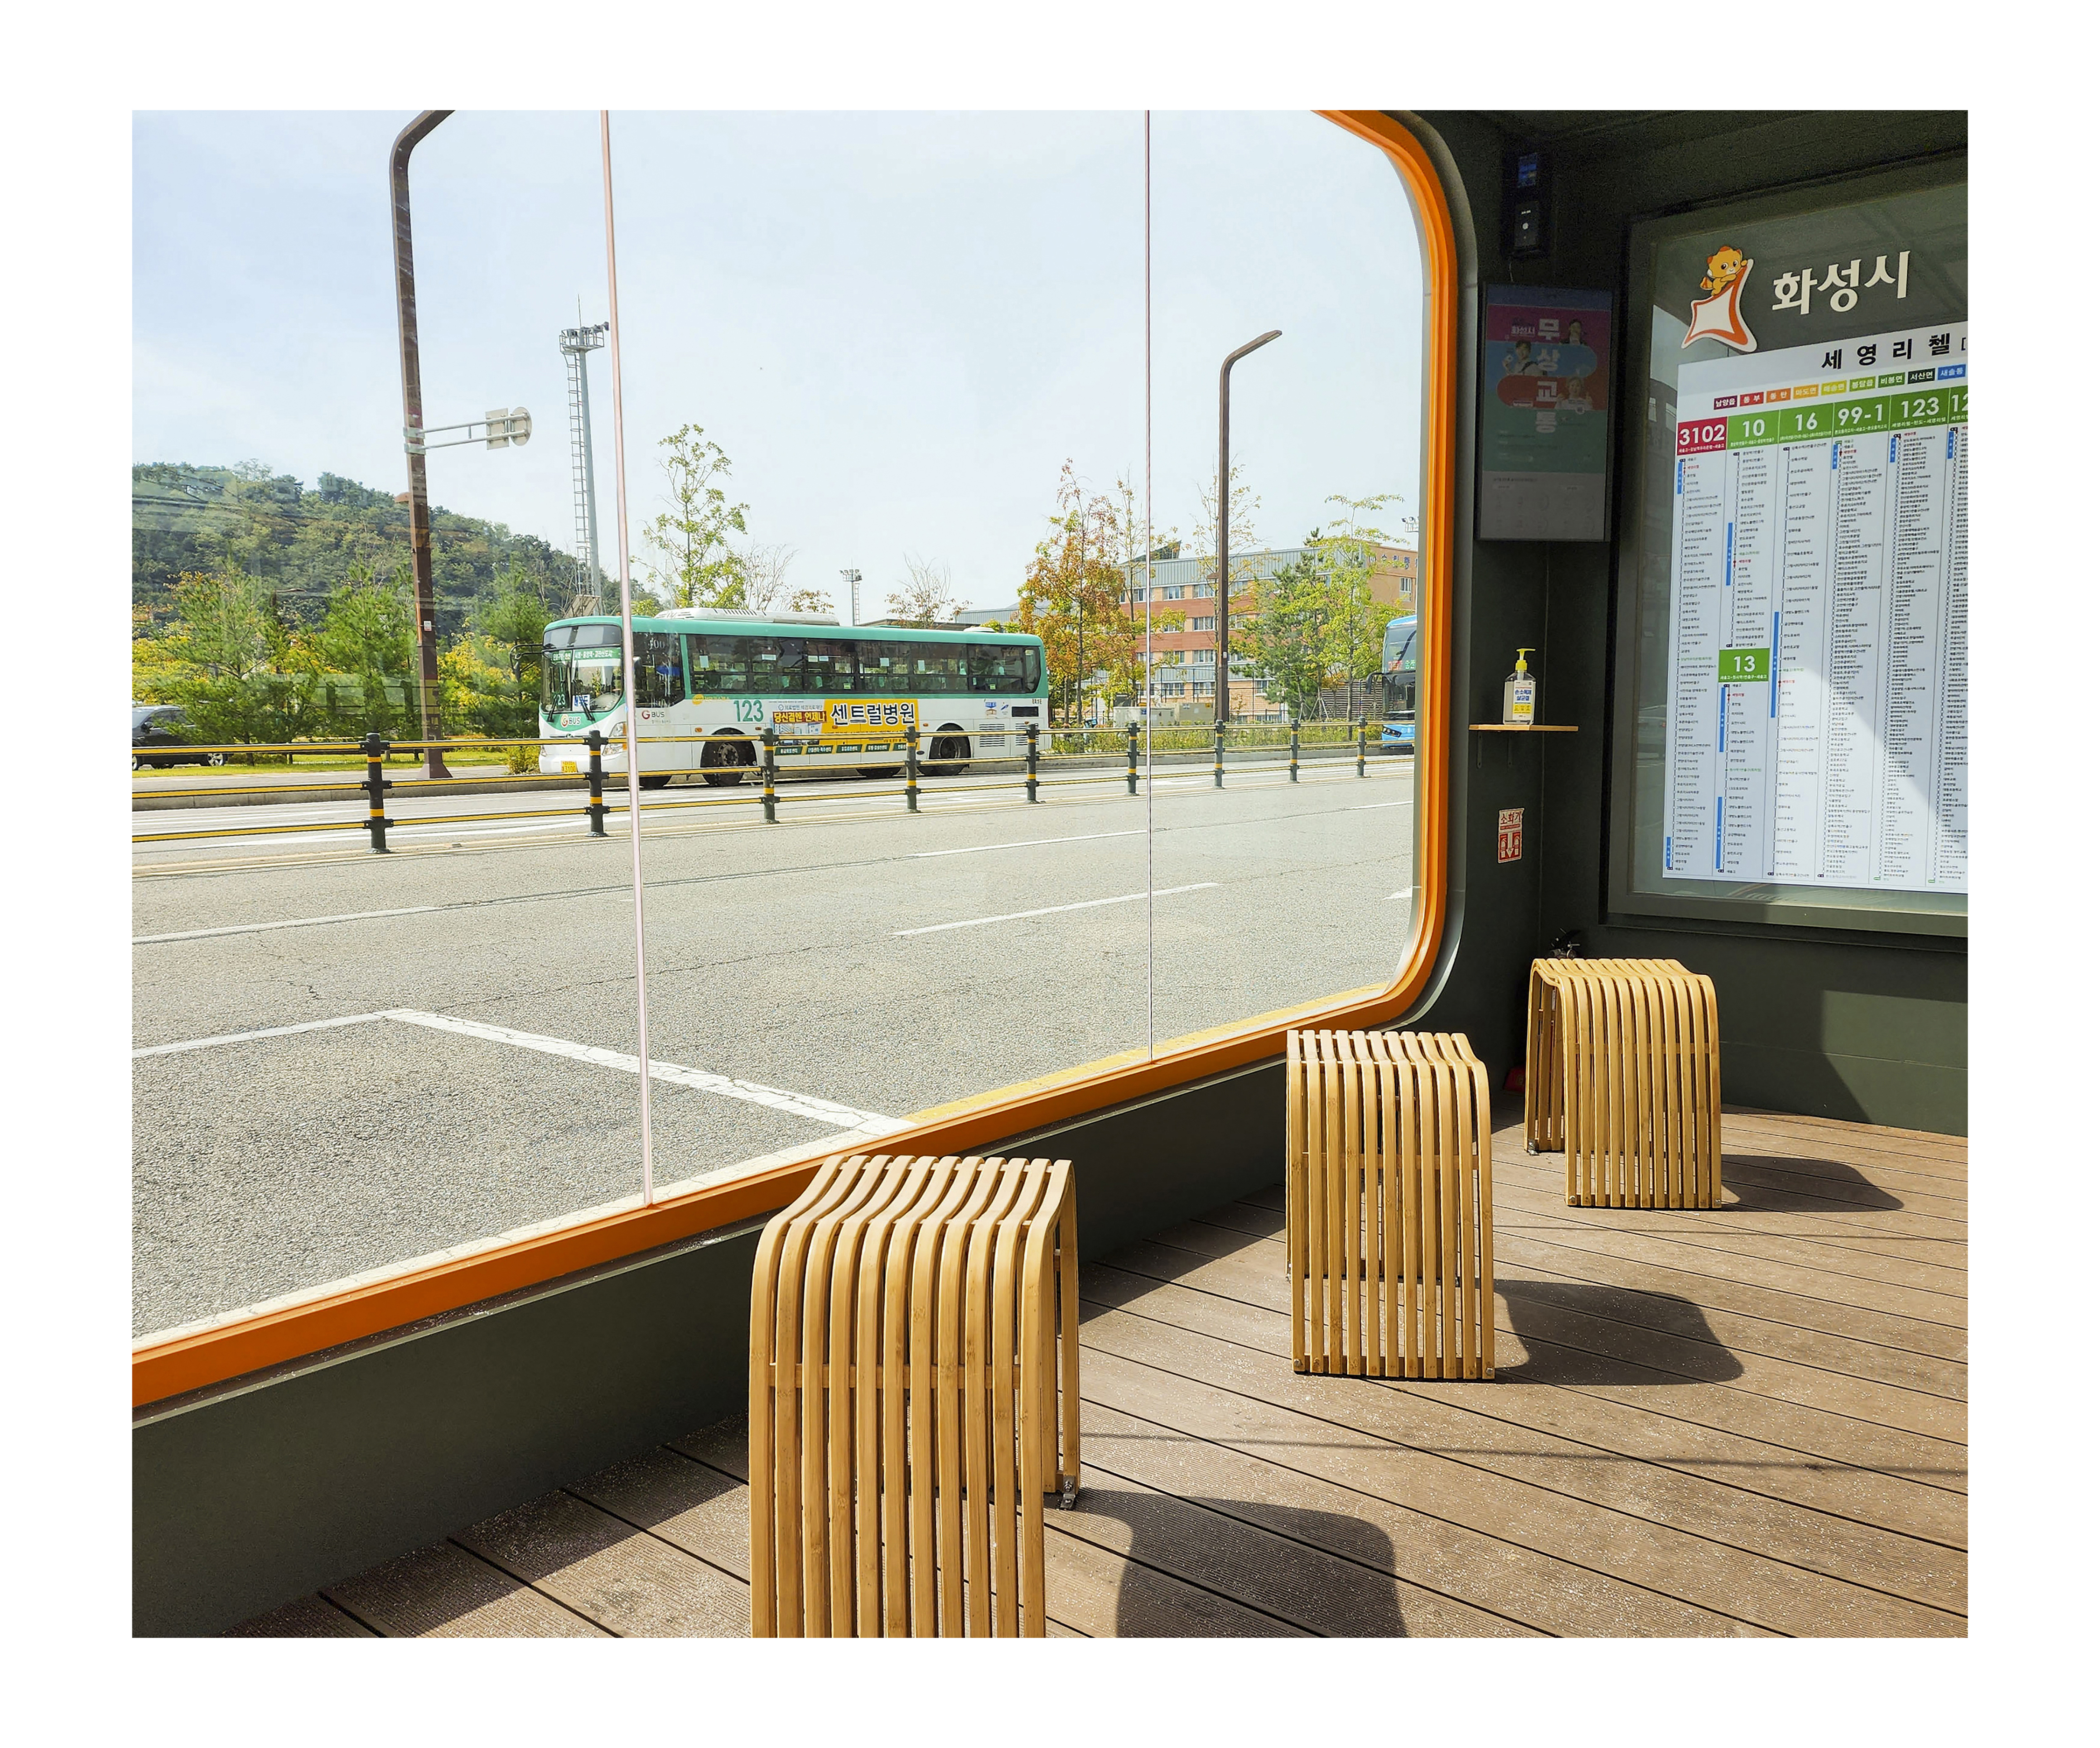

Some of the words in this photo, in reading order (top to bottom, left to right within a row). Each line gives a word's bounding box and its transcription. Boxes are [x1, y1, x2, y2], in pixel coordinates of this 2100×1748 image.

[1772, 251, 1911, 315] 화성시
[1838, 404, 1883, 426] 99-1
[1901, 397, 1939, 419] 123
[1743, 419, 1765, 438] 10
[1795, 412, 1818, 431] 16
[1679, 424, 1725, 446] 3102
[1734, 656, 1756, 672] 13
[733, 700, 764, 722] 123
[804, 711, 826, 722] 언제나
[830, 703, 915, 725] 센트럴병원
[1500, 811, 1521, 825] 소화기
